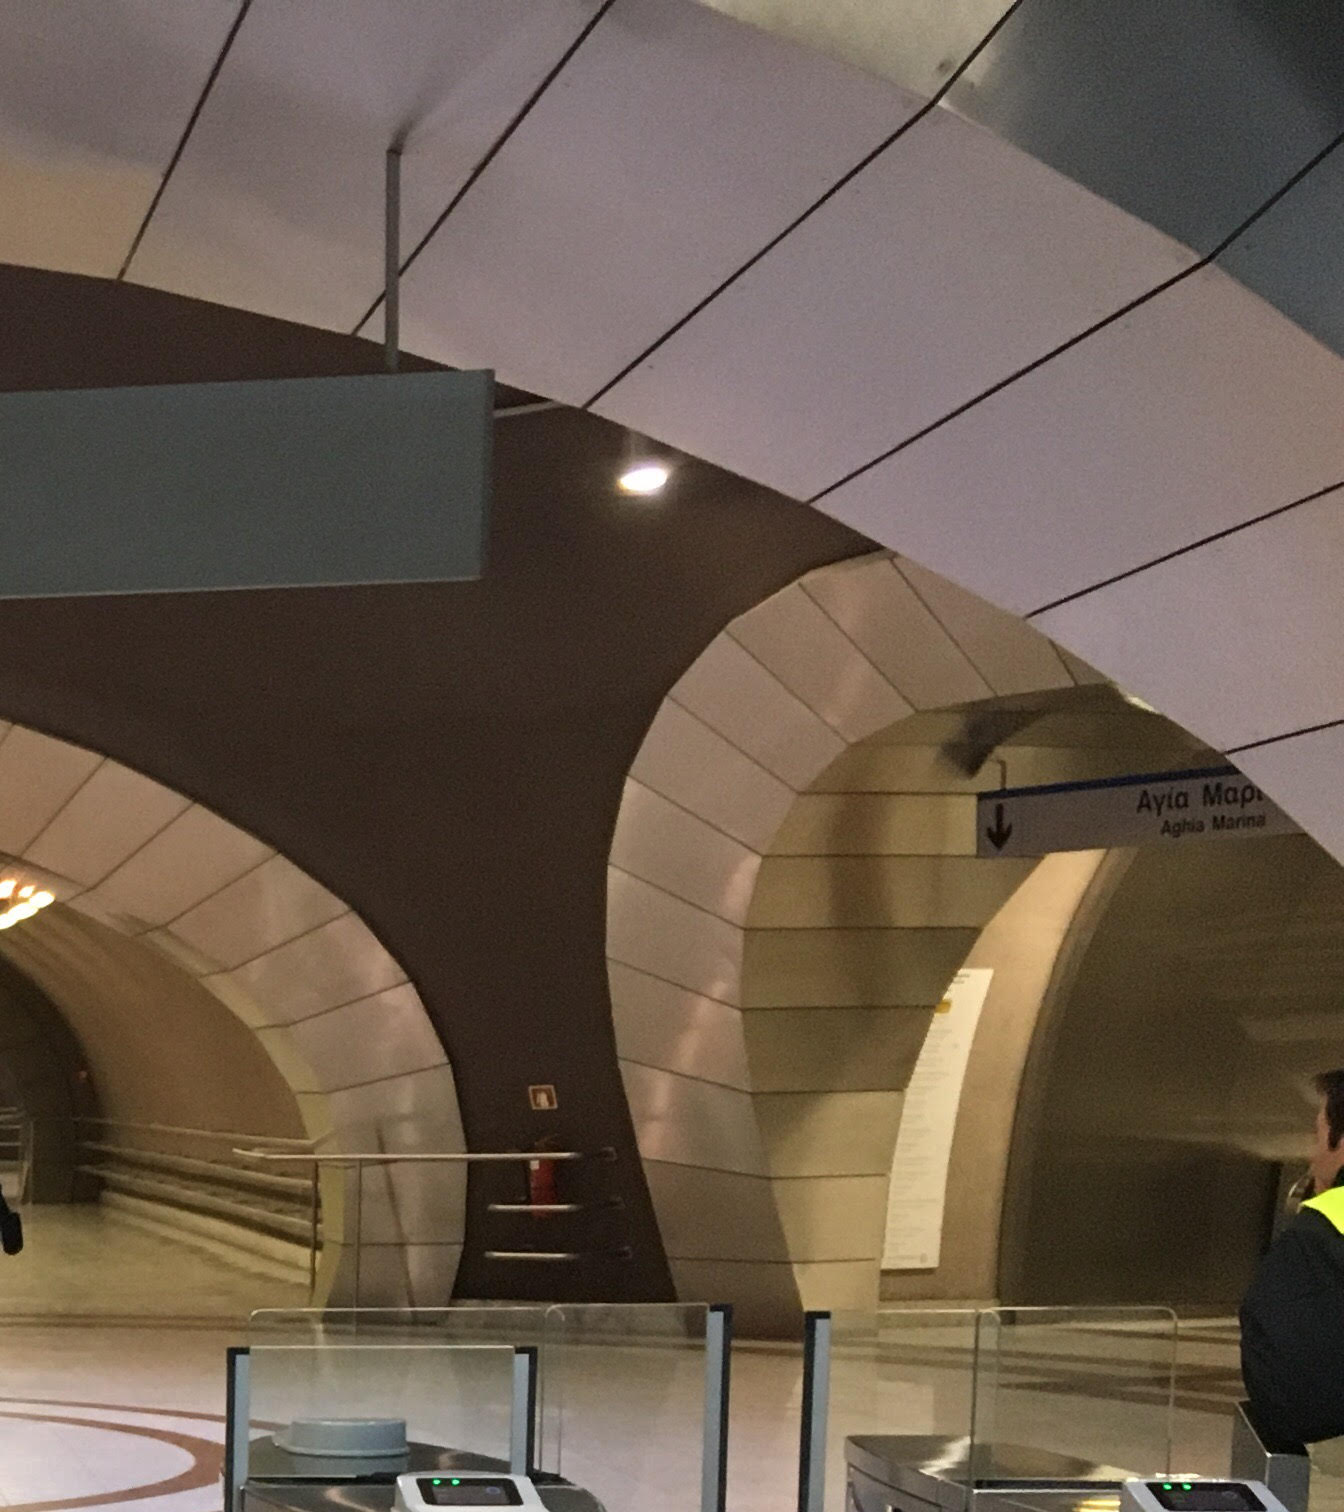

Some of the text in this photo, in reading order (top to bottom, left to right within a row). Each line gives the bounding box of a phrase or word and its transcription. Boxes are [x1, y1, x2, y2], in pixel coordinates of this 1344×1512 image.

[1136, 788, 1189, 816] Αγία
[1160, 814, 1266, 838] Aghia Marina
